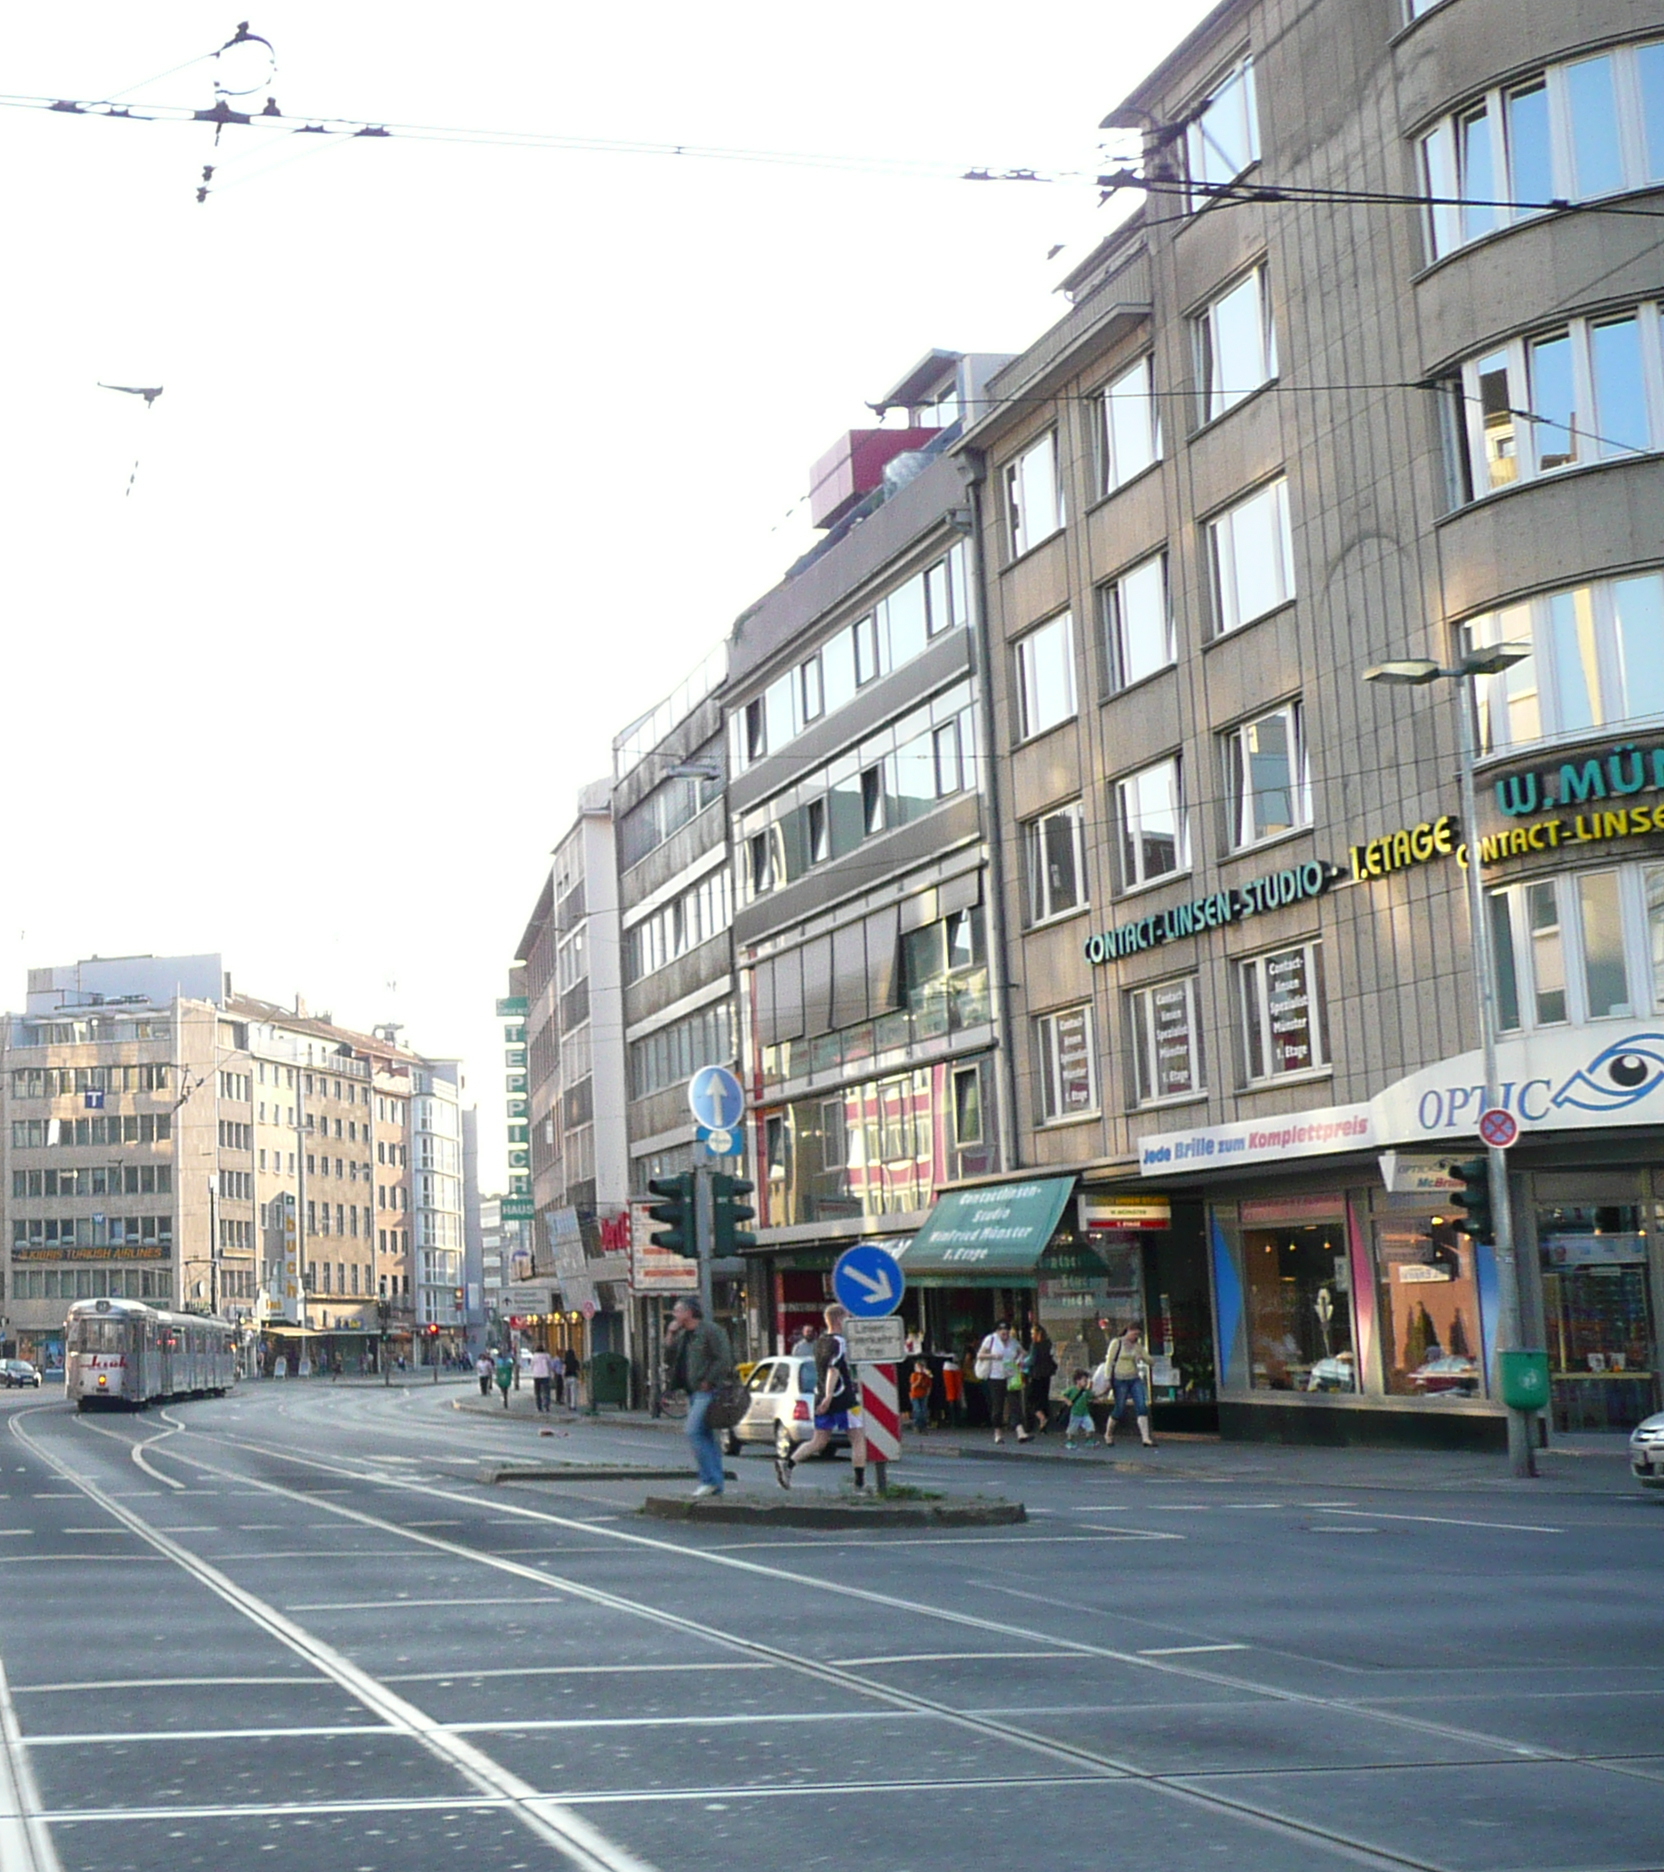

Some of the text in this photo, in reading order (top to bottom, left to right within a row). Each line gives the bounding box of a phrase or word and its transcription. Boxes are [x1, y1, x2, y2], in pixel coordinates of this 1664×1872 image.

[504, 1025, 528, 1192] TEPPICH
[1418, 1078, 1552, 1130] OPTIC
[1143, 1114, 1369, 1165] Jede Brille zum Komplettpreis
[501, 1204, 534, 1215] HAUS
[981, 1225, 1033, 1241] Münster
[114, 1247, 162, 1259] AIRLINES
[287, 1215, 297, 1299] buch
